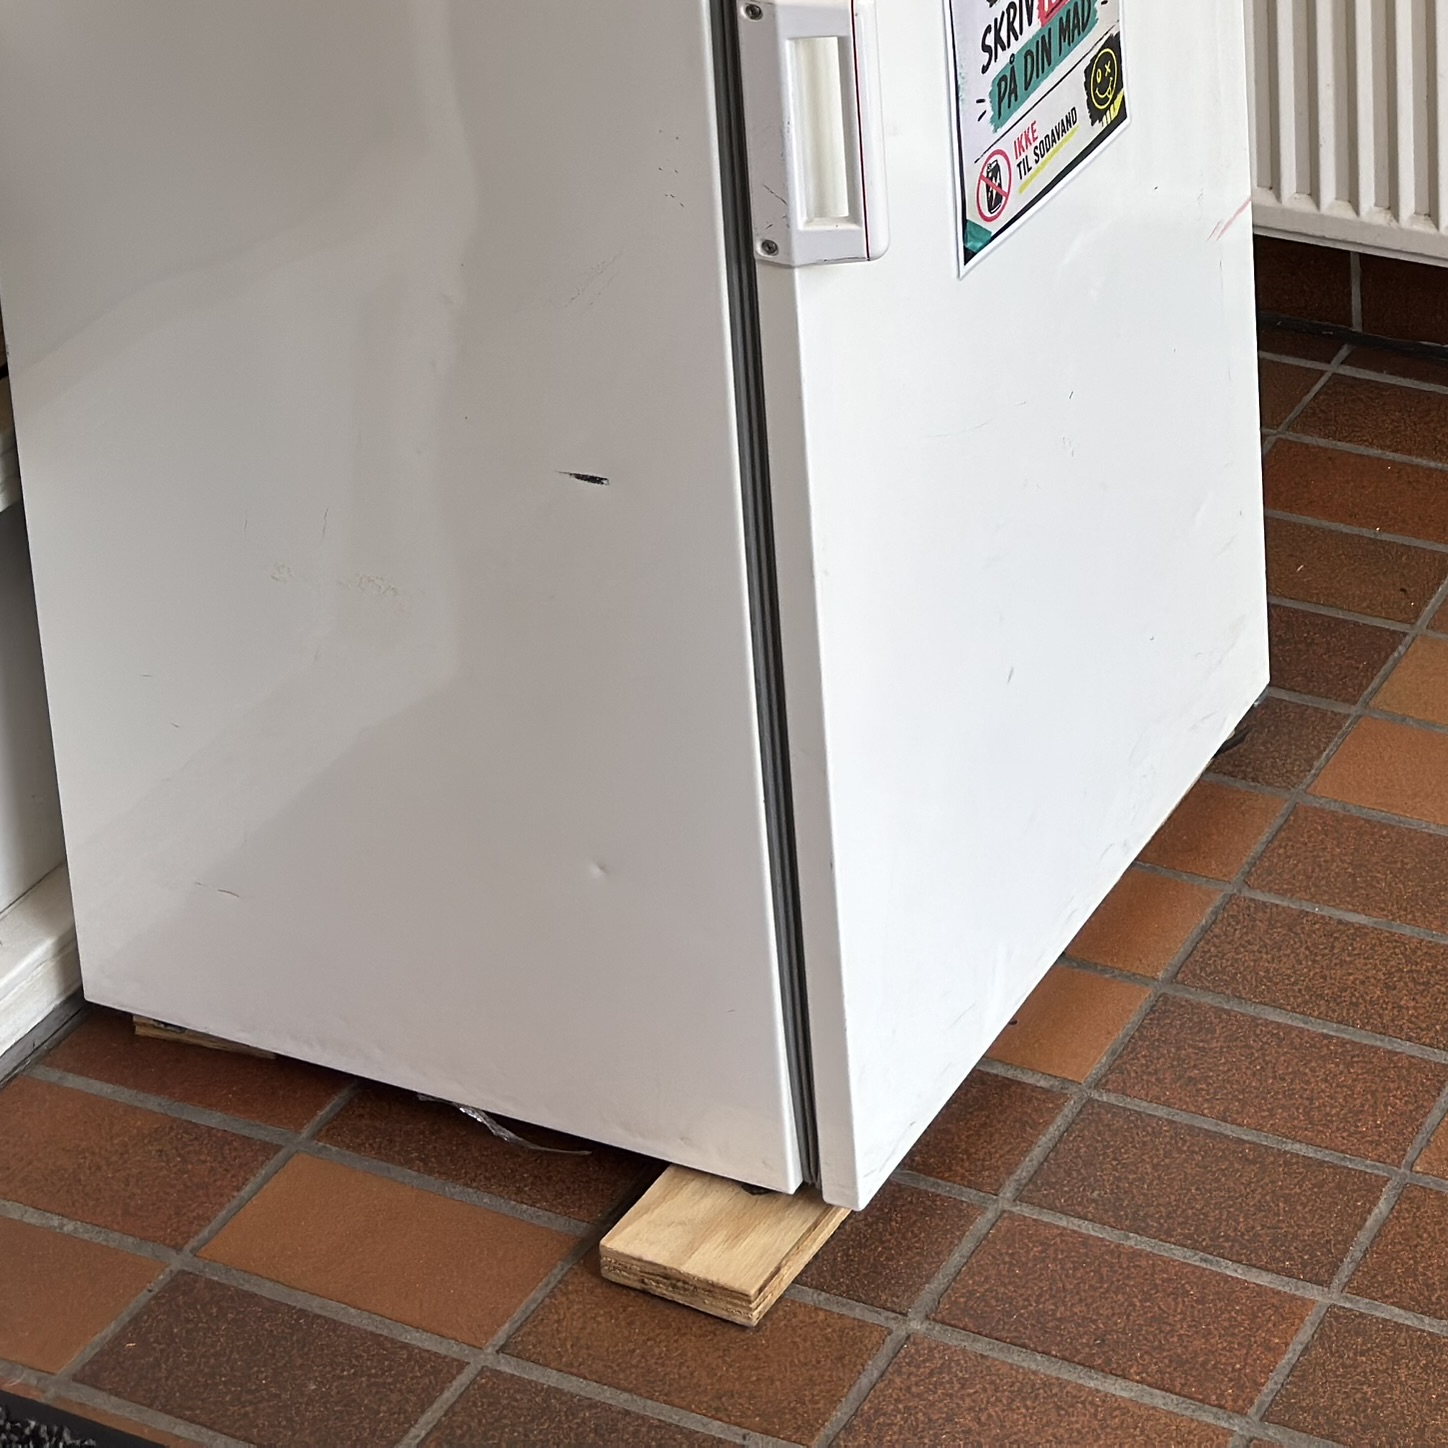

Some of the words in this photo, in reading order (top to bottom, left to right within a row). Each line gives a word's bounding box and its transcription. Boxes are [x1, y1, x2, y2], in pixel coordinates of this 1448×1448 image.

[997, 53, 1018, 119] PÅ
[1024, 27, 1052, 91] DIN
[1059, 2, 1092, 56] MAD
[1013, 120, 1039, 160] IKKE
[1017, 159, 1032, 180] TIL
[1034, 106, 1077, 164] SODAVAND
